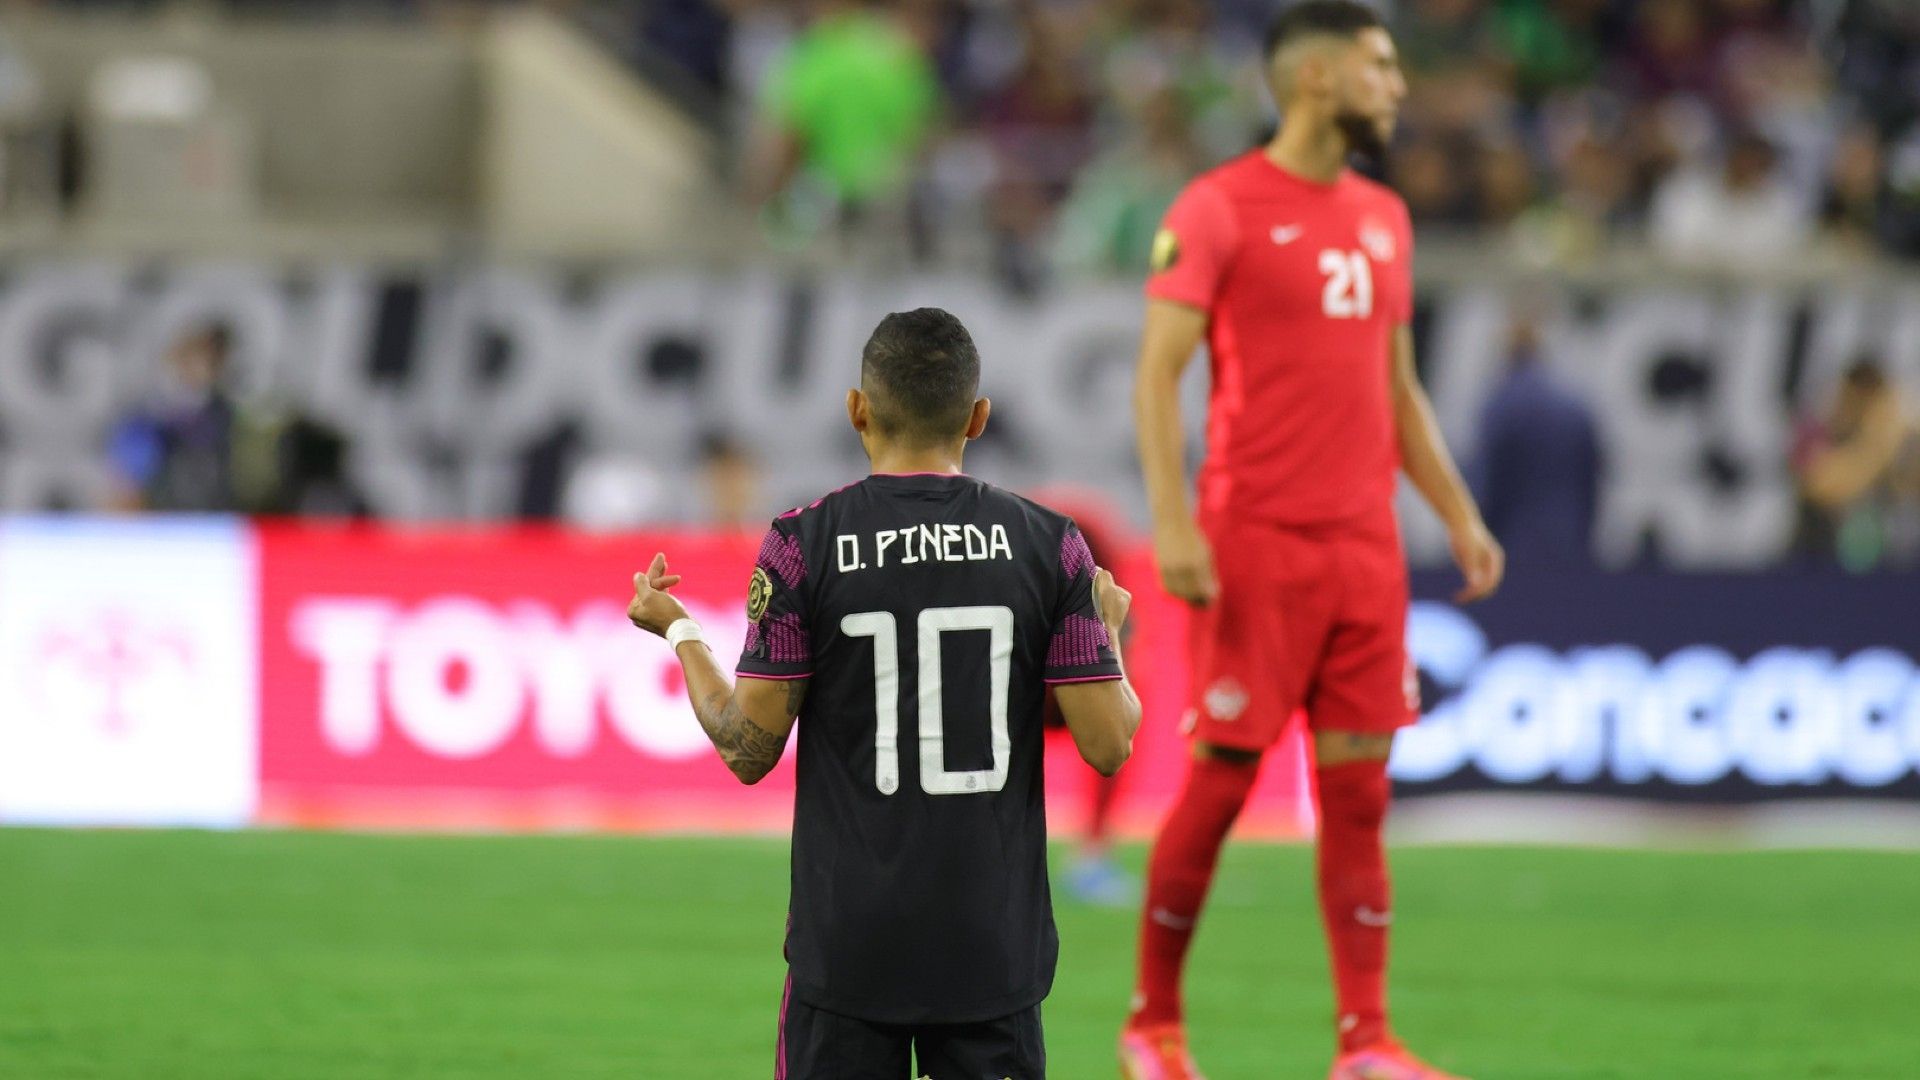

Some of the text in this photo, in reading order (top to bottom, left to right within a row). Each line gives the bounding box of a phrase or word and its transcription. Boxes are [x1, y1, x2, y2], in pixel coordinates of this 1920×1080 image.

[1318, 248, 1373, 320] 21
[875, 522, 1013, 568] PINEDA
[290, 594, 798, 758] TOYO
[840, 605, 1014, 796] 10
[1387, 602, 1920, 785] Concac
